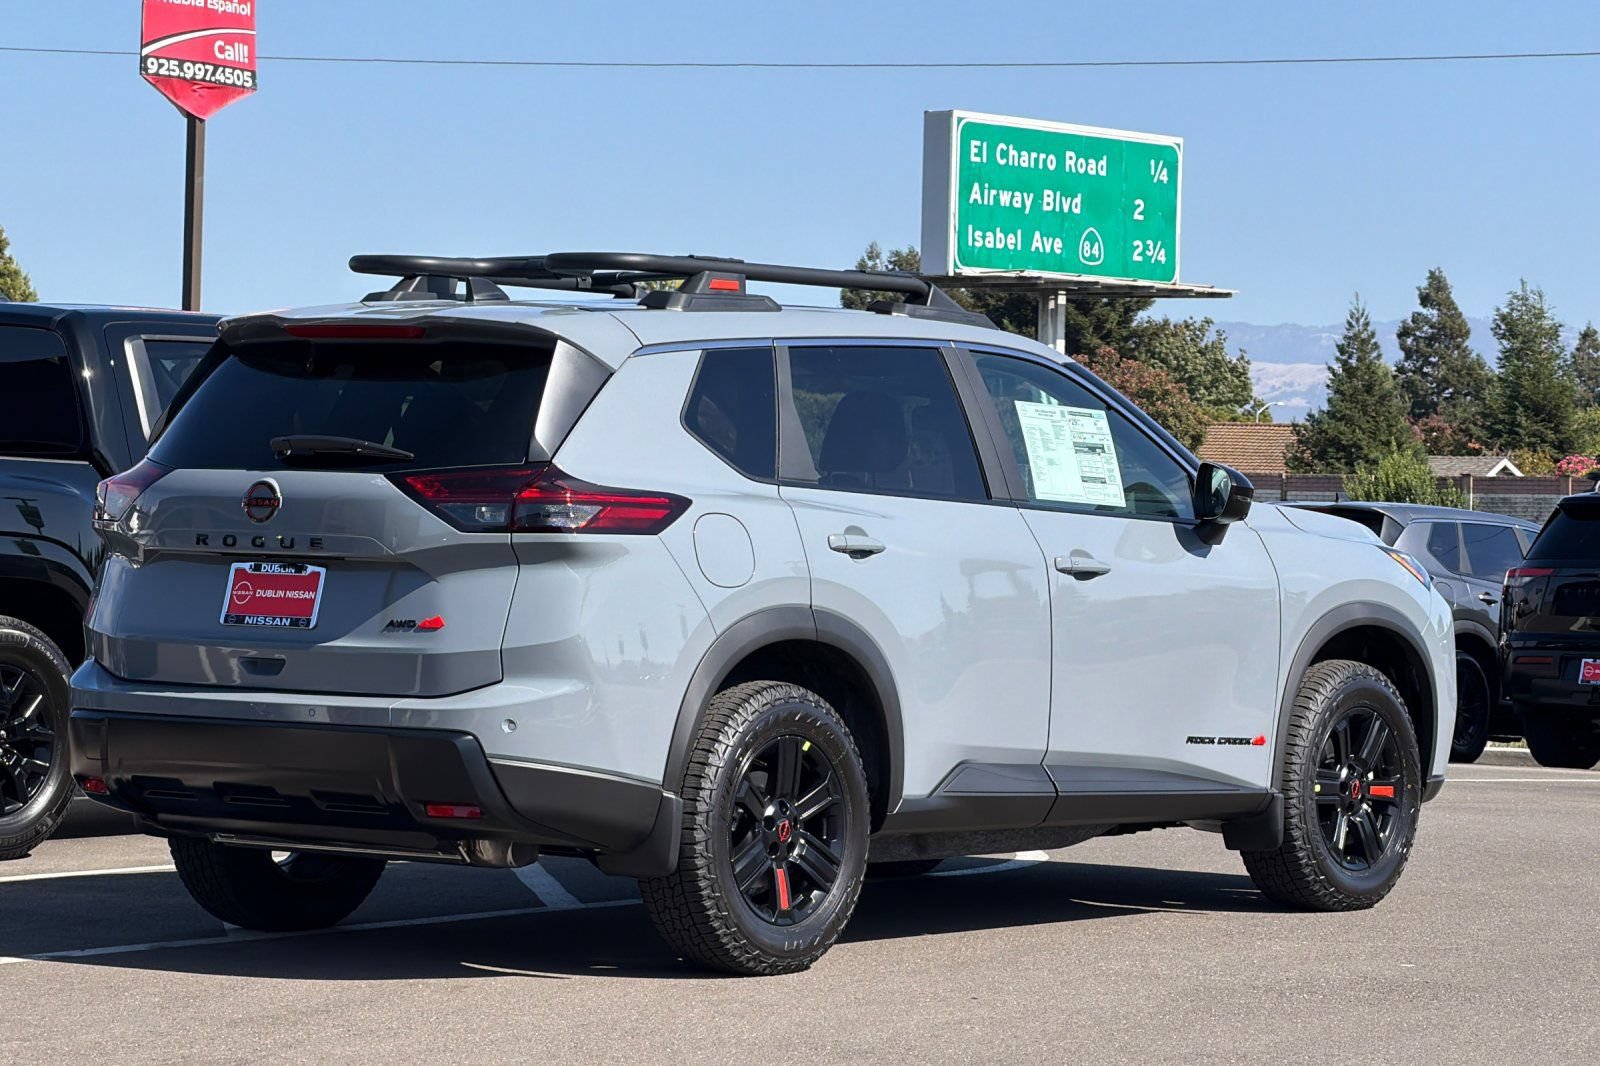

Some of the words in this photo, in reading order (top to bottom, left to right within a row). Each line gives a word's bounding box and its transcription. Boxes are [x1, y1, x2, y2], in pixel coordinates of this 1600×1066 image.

[207, 0, 251, 17] Español
[214, 40, 249, 64] Call!
[146, 57, 253, 87] 925.997.4505
[969, 139, 987, 163] El
[995, 143, 1057, 171] Charro
[1065, 150, 1107, 177] Road
[969, 182, 1034, 215] Airway
[1042, 189, 1082, 215] Blvd
[1133, 199, 1145, 221] 2
[967, 224, 1022, 251] Isabel
[1030, 230, 1063, 254] Ave
[1082, 240, 1099, 259] 84
[195, 533, 324, 550] ROGUE
[255, 589, 285, 598] DUBLIN
[285, 590, 316, 599] NISSAN
[244, 615, 291, 626] NISSAN
[385, 619, 417, 628] AWD
